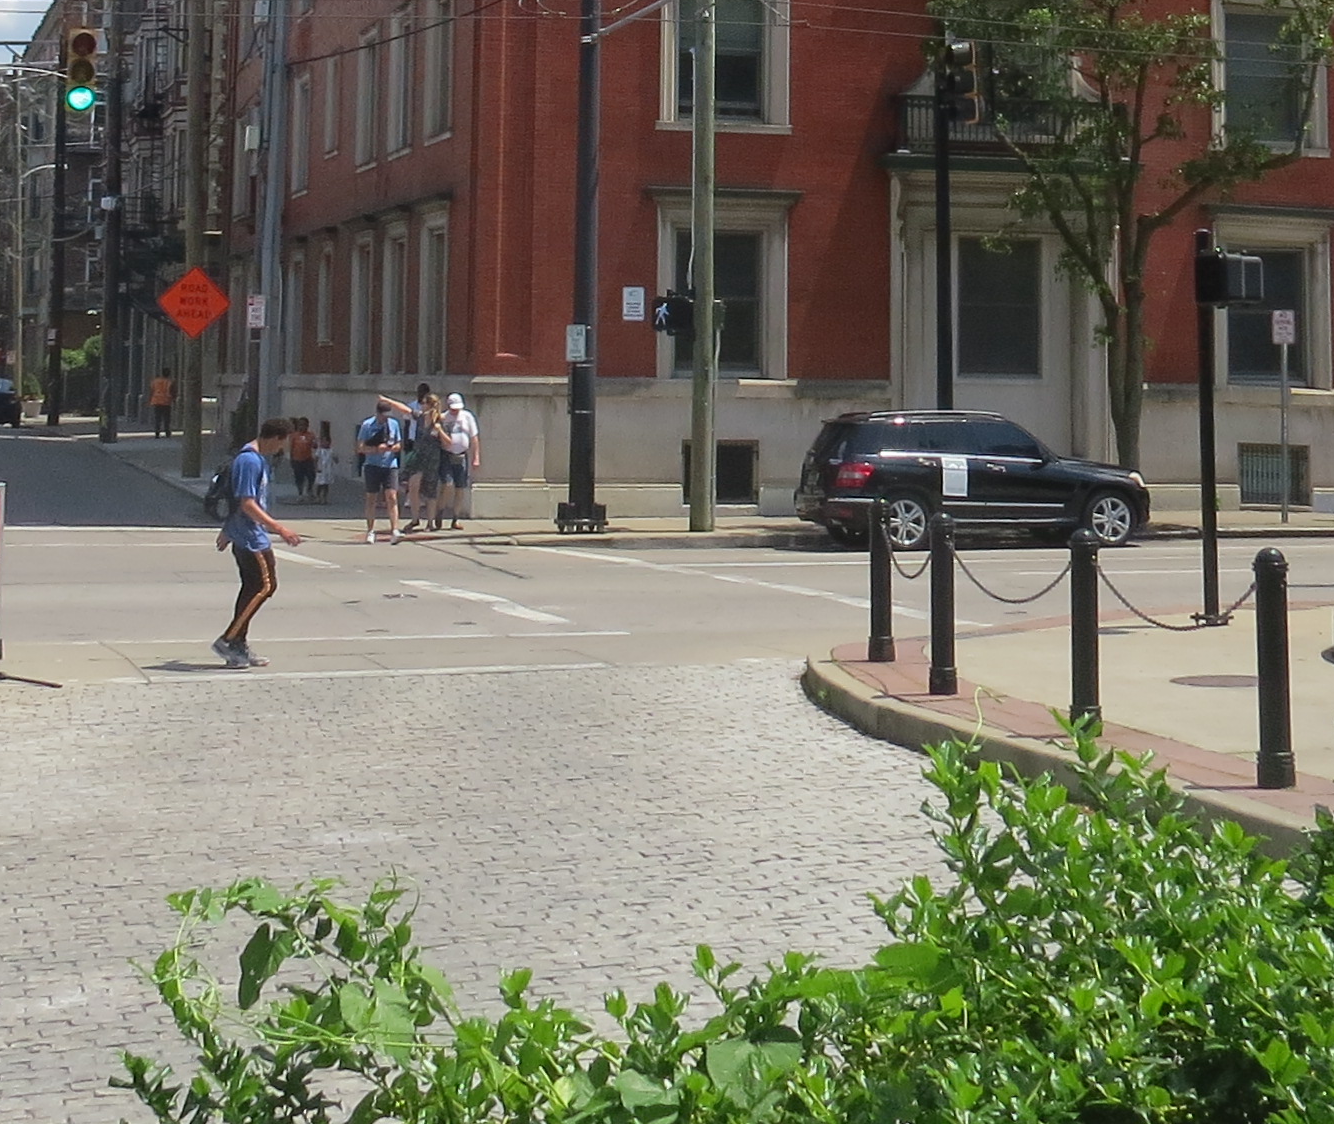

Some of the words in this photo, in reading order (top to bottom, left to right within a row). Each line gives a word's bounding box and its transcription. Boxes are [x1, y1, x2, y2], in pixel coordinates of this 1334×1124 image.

[181, 283, 208, 292] ROAD
[180, 297, 209, 306] WORK
[177, 309, 213, 319] AHEAD
